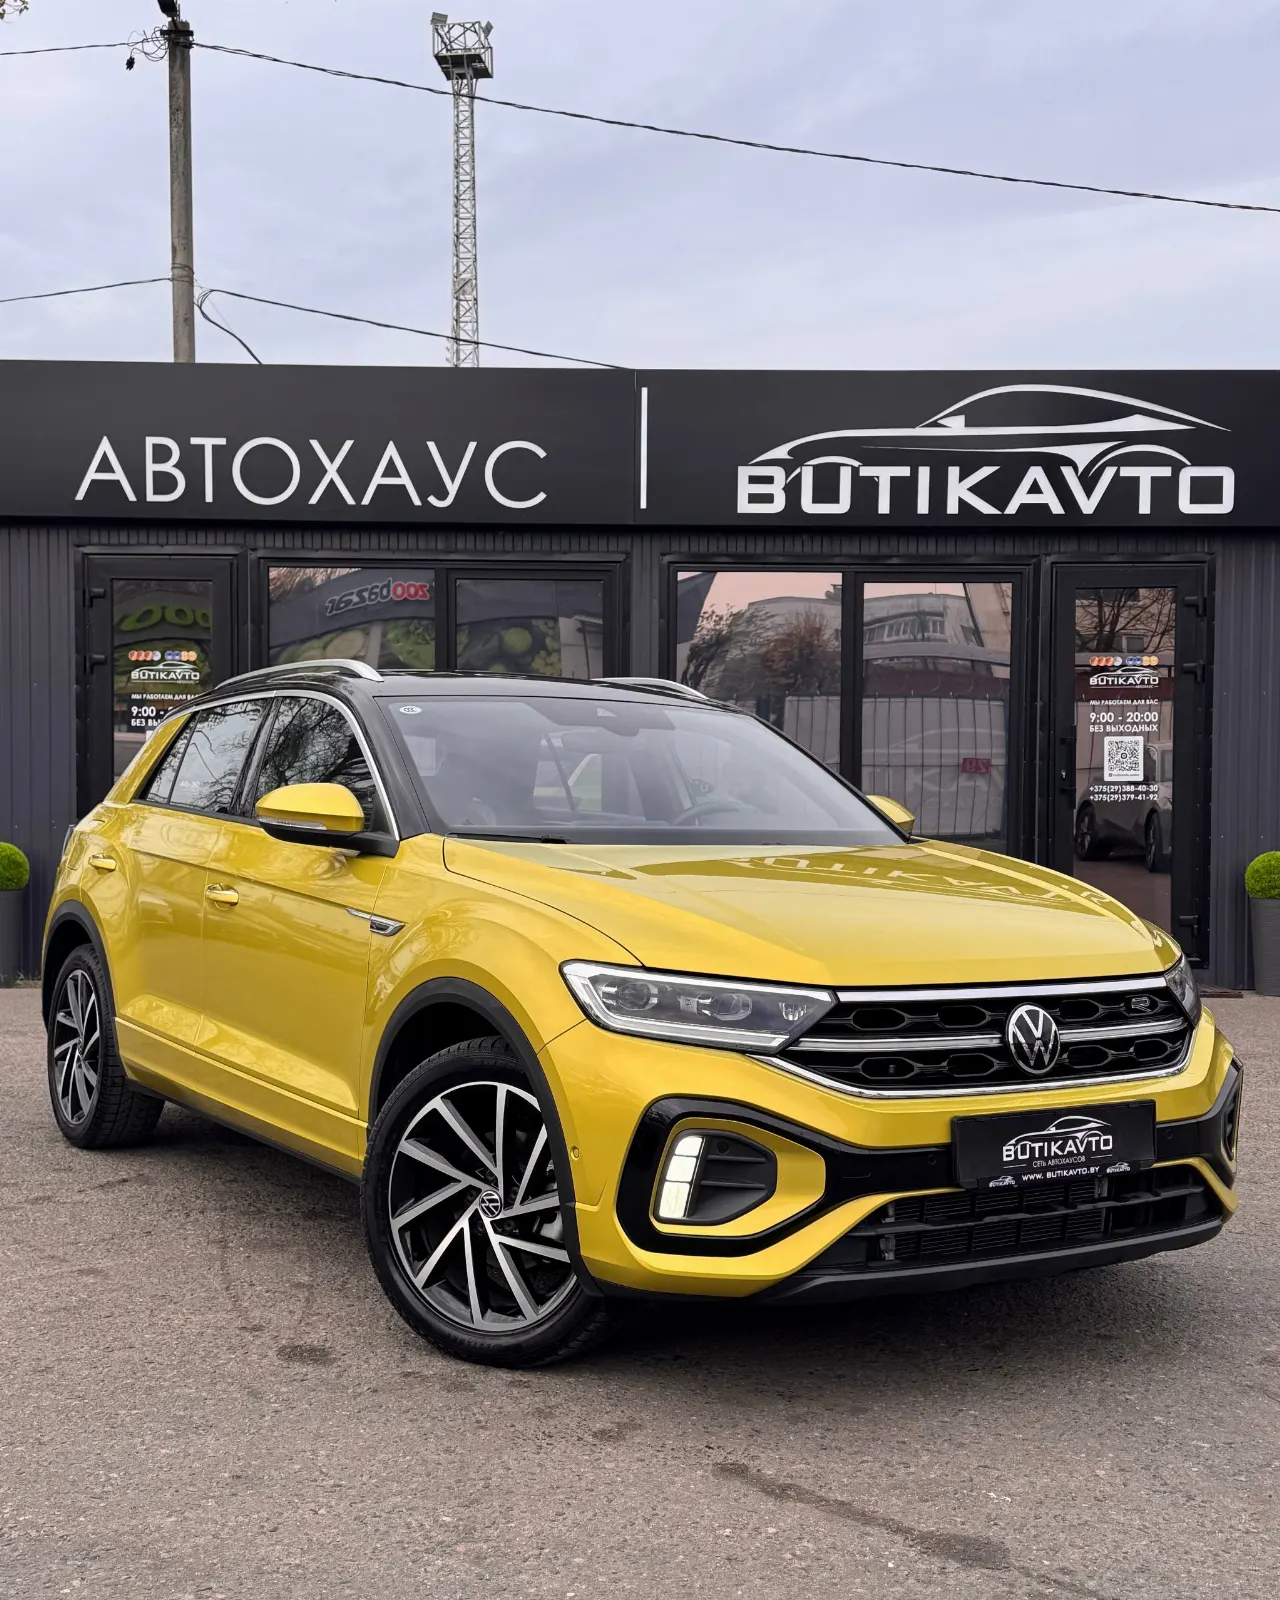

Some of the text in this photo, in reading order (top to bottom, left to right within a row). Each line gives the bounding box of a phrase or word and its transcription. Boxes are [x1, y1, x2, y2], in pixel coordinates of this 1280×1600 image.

[74, 435, 548, 509] АВТОХАУС
[737, 464, 1235, 515] BUTIKAVTO
[131, 671, 200, 680] BUTIKAVTO
[1089, 676, 1159, 685] BUTIKAVTO
[131, 706, 156, 717] 9:00
[1089, 712, 1115, 723] 9:00
[1126, 712, 1159, 723] 20:00
[1089, 724, 1158, 733] БЕЗ ВЫХОДНЫХ
[1089, 785, 1159, 793] +375(29)388-40-30
[1089, 794, 1159, 803] +375(29)379-41-92
[1002, 1134, 1113, 1162] BUTIKAVTO
[1032, 1155, 1086, 1168] СЕТЬ АВТОХАУСОВ
[1021, 1165, 1100, 1182] WWW. BUTIKAVTO.BY
